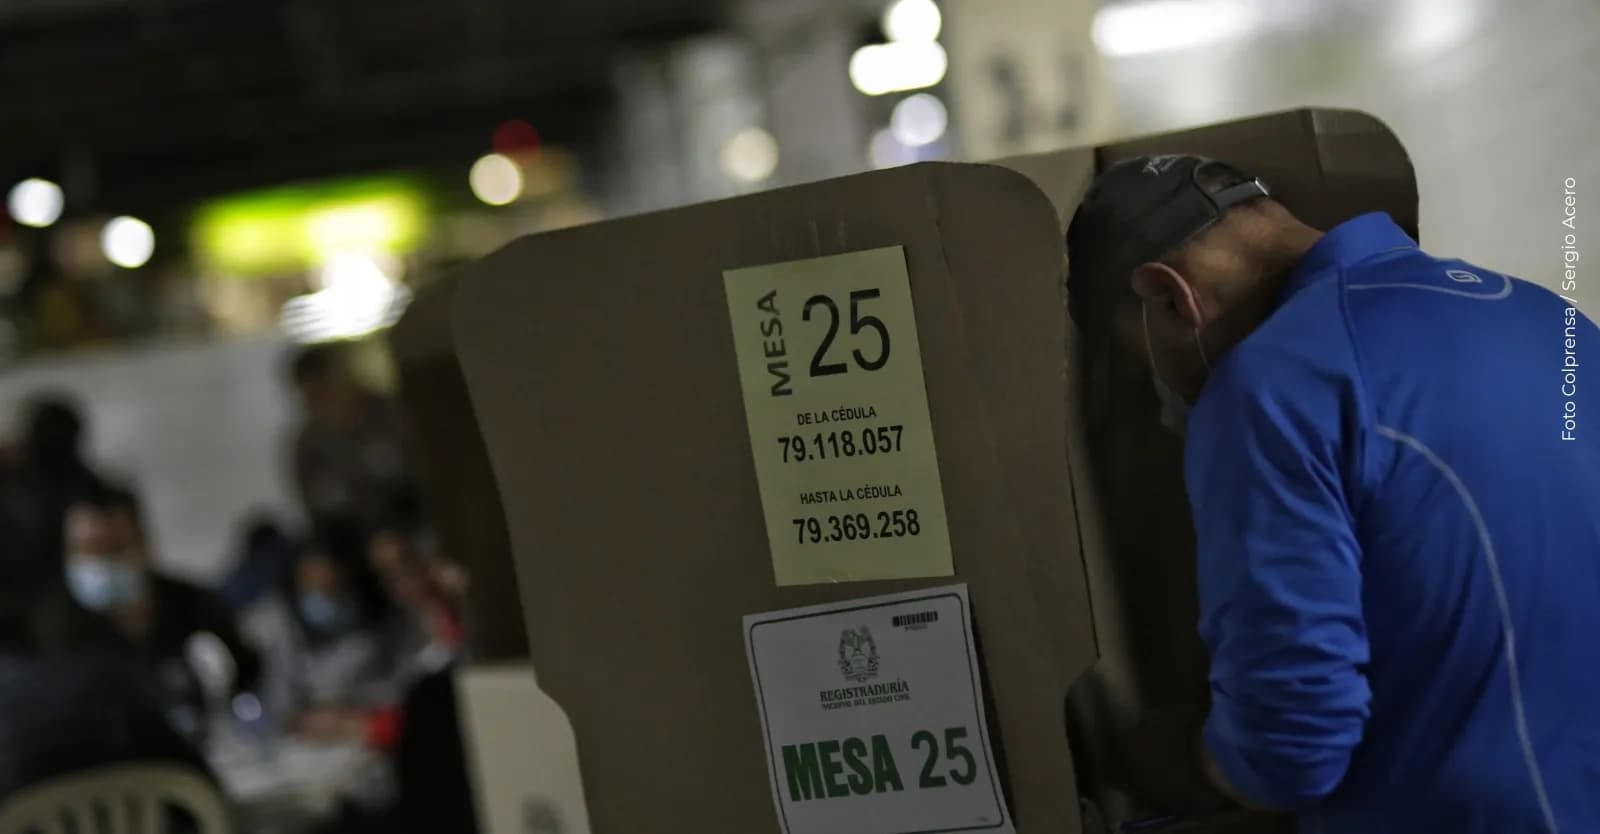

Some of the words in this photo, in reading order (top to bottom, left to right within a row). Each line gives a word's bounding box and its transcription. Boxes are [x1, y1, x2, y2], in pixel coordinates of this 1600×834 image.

[757, 289, 793, 397] MESA
[802, 288, 891, 377] 25
[797, 412, 812, 426] DE
[814, 411, 830, 424] LA
[831, 405, 877, 422] CÉDULA
[777, 425, 904, 463] 79.118.057
[800, 490, 838, 505] HASTA
[840, 489, 855, 502] LA
[856, 483, 903, 500] CÉDULA
[792, 508, 921, 544] 79.369.258
[819, 678, 910, 702] REGISTRADURÍA
[781, 734, 905, 802] MESA
[911, 727, 977, 789] 25
